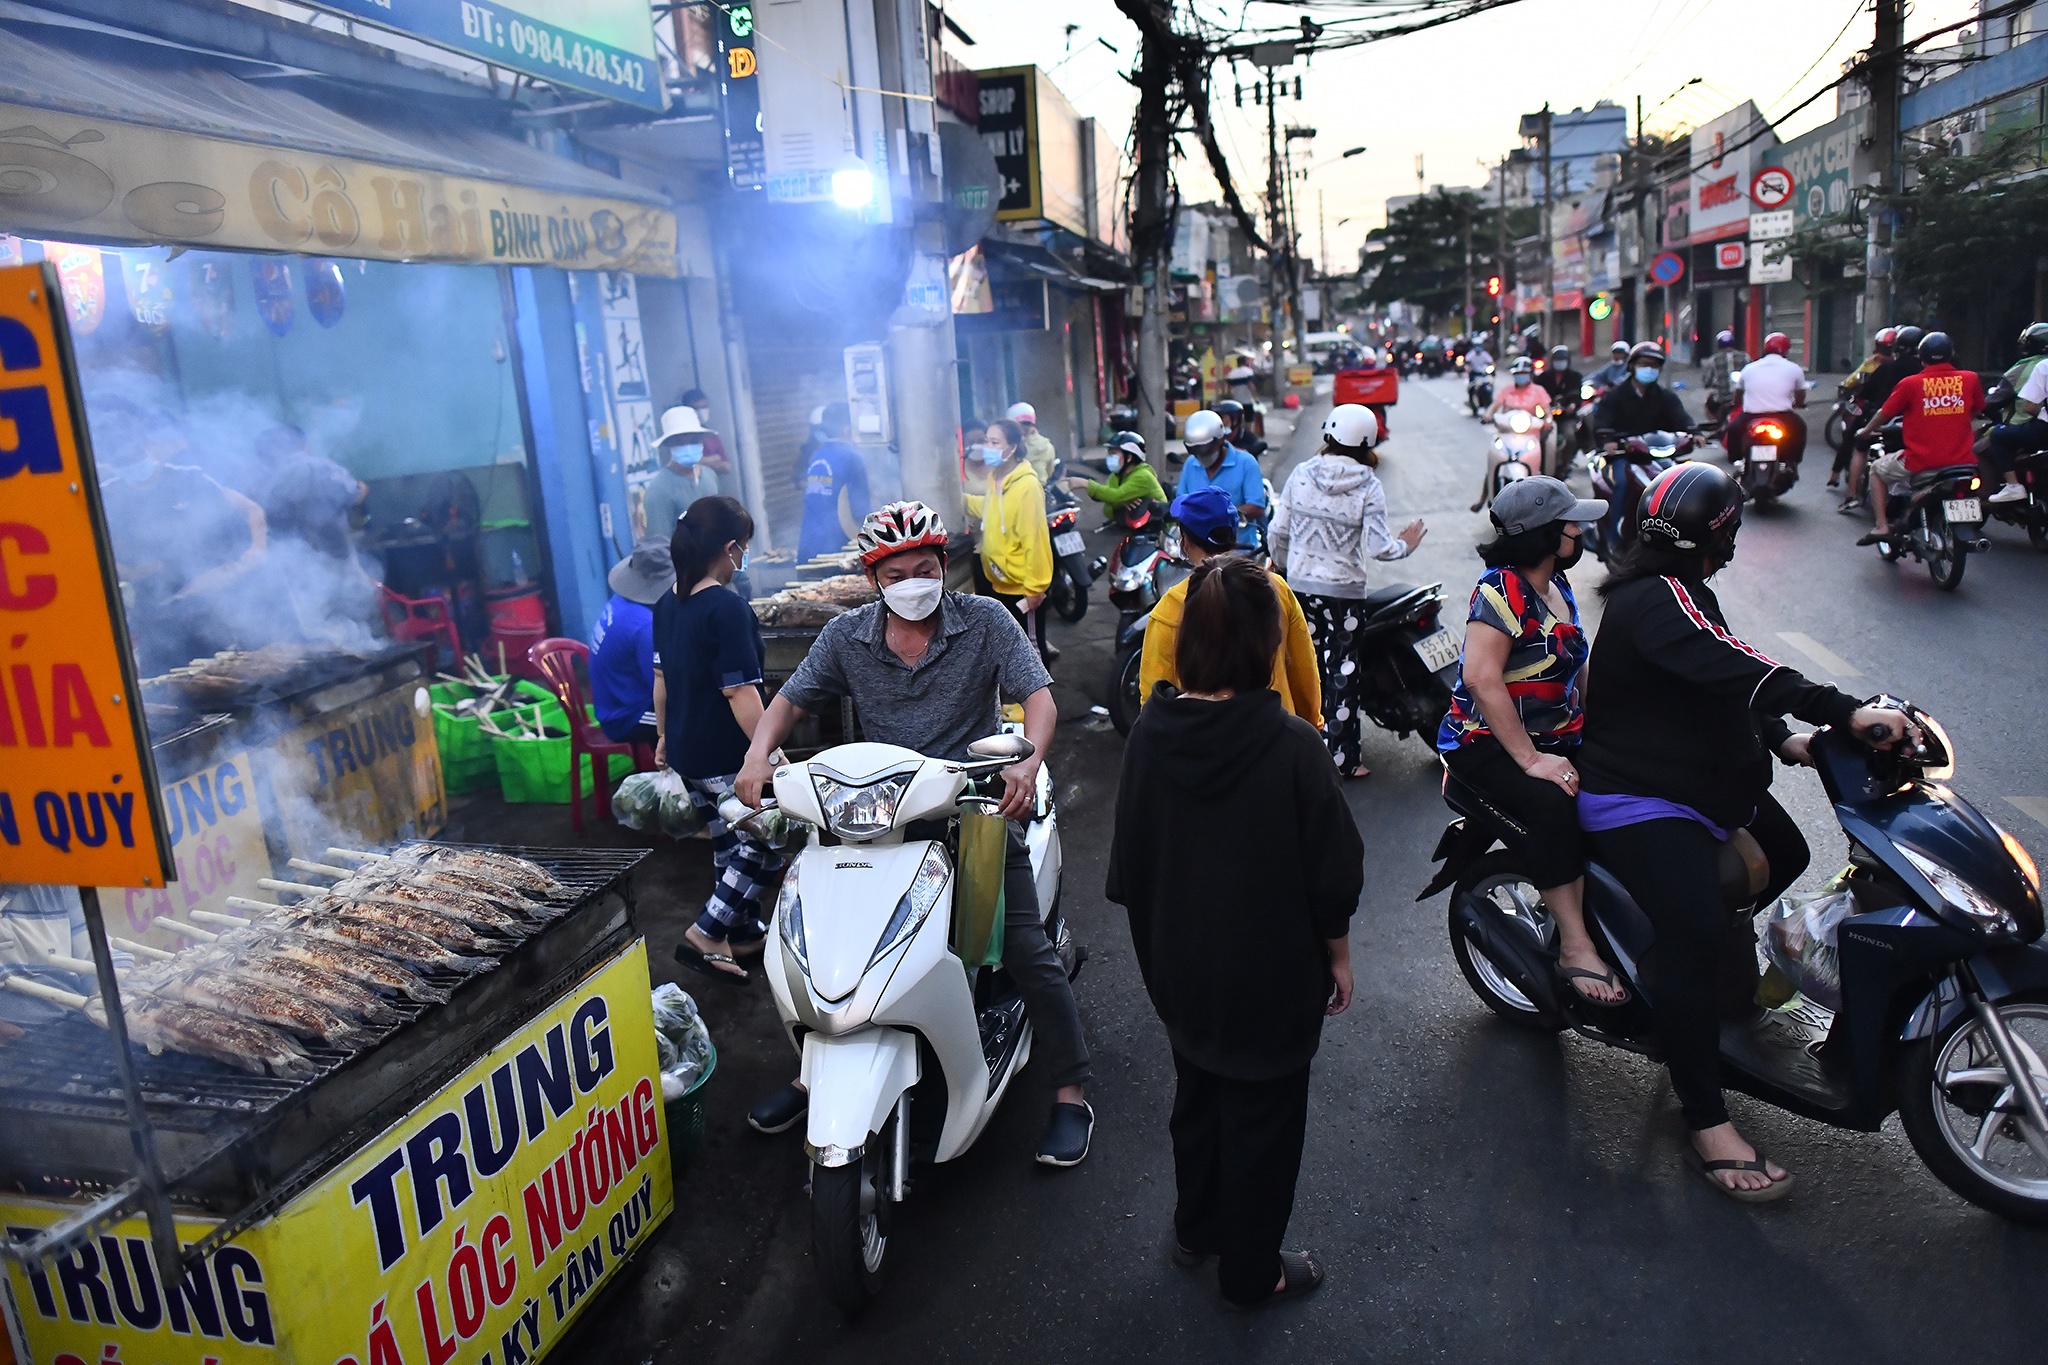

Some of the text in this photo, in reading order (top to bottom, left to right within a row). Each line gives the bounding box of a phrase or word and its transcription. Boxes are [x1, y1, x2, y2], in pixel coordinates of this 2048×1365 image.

[461, 0, 647, 92] ĐT: 0984.428.542
[978, 86, 1016, 115] SHOP
[250, 160, 359, 247] Cô
[370, 174, 487, 255] Hai
[490, 197, 545, 259] BÌNH
[548, 204, 590, 261] DÂN
[1922, 375, 1963, 390] MADE
[1923, 384, 1964, 397] WITH
[1923, 406, 1965, 416] PASSION
[1420, 630, 1452, 654] 55-P7
[0, 633, 112, 748] ÍA
[304, 702, 417, 786] TRUNG
[34, 773, 135, 854] QUÝ
[834, 861, 874, 870] HONDA
[1848, 931, 1894, 951] HONDA
[349, 994, 616, 1273] TRUNG
[415, 1214, 517, 1365] LÓC
[522, 1077, 660, 1270] NƯỚNG
[6, 1226, 275, 1345] TRUNG
[501, 1173, 653, 1365] KỲ TÂN QUÝ
